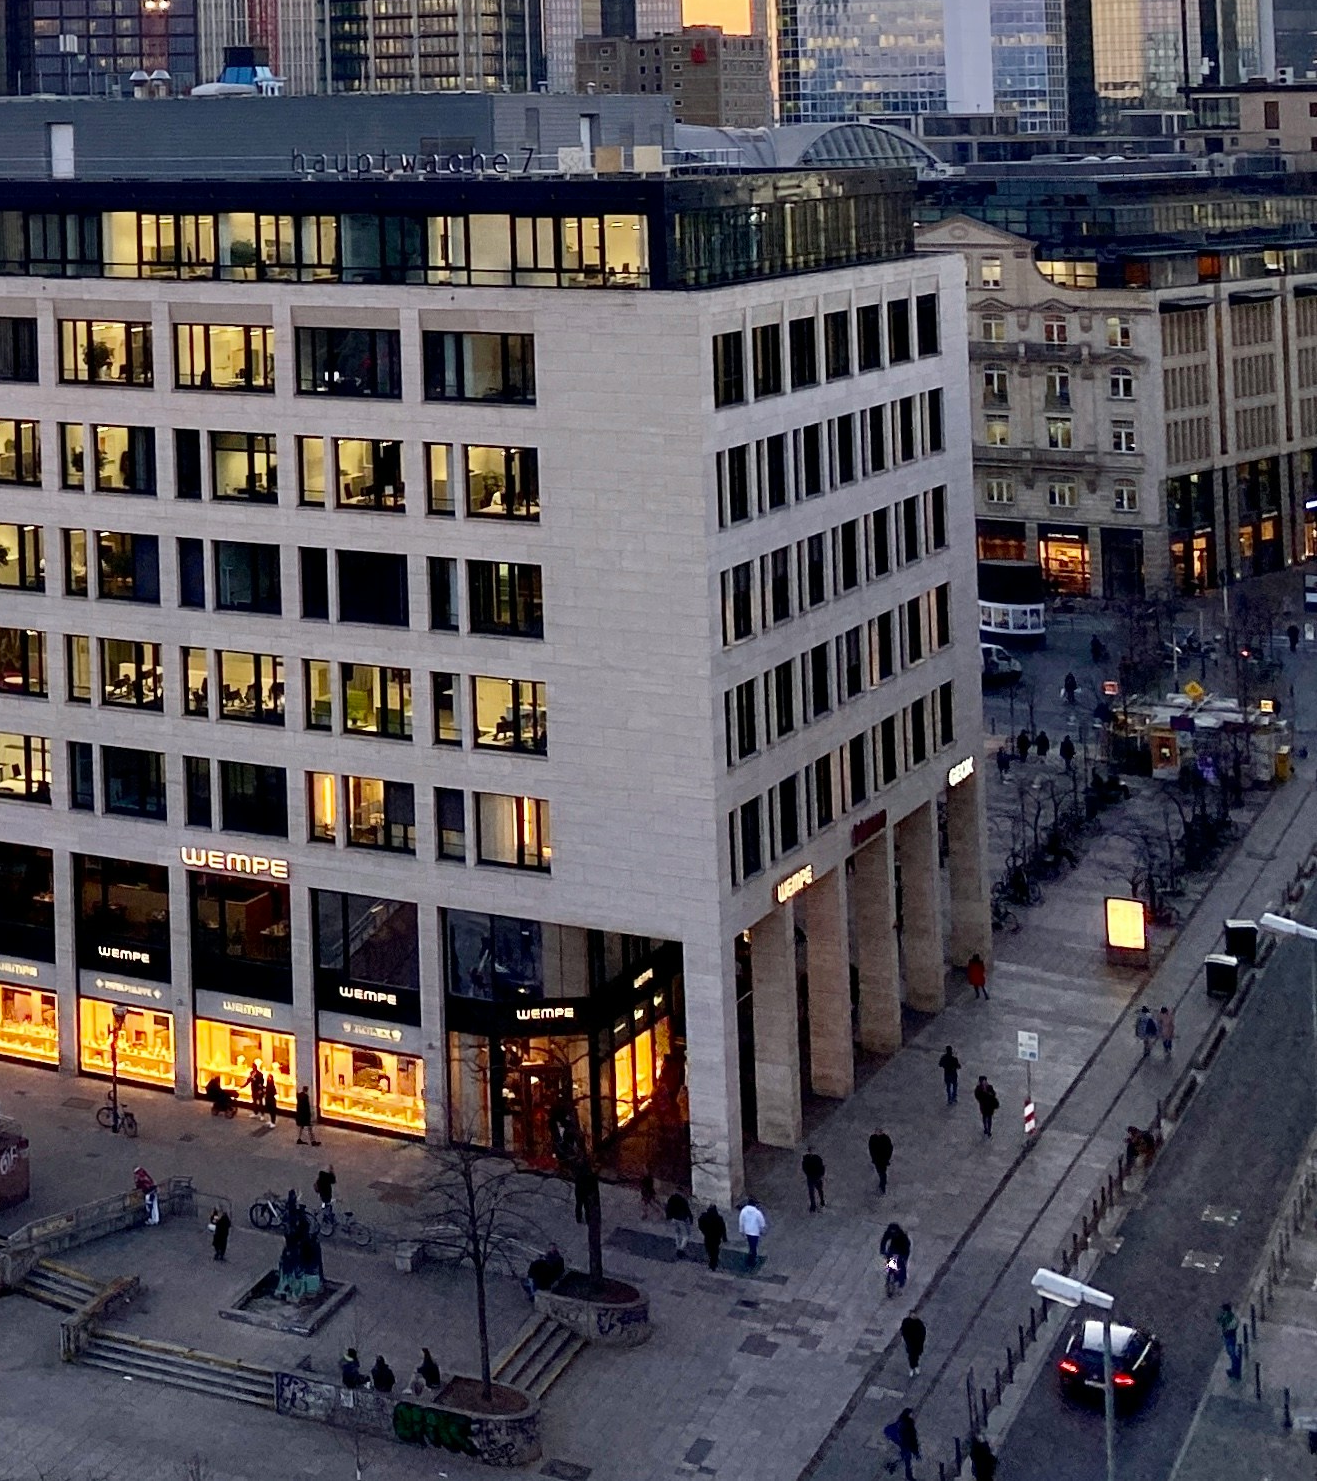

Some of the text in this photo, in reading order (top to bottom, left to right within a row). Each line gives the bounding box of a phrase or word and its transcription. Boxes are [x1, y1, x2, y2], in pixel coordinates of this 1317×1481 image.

[291, 146, 535, 180] hauptwache 7
[180, 846, 289, 879] WEMPE
[776, 864, 814, 904] WEMPE
[97, 945, 150, 964] WEMPE
[339, 985, 397, 1006] WEMPE
[223, 1000, 272, 1018] WEMPE
[516, 1007, 574, 1021] WEMPE
